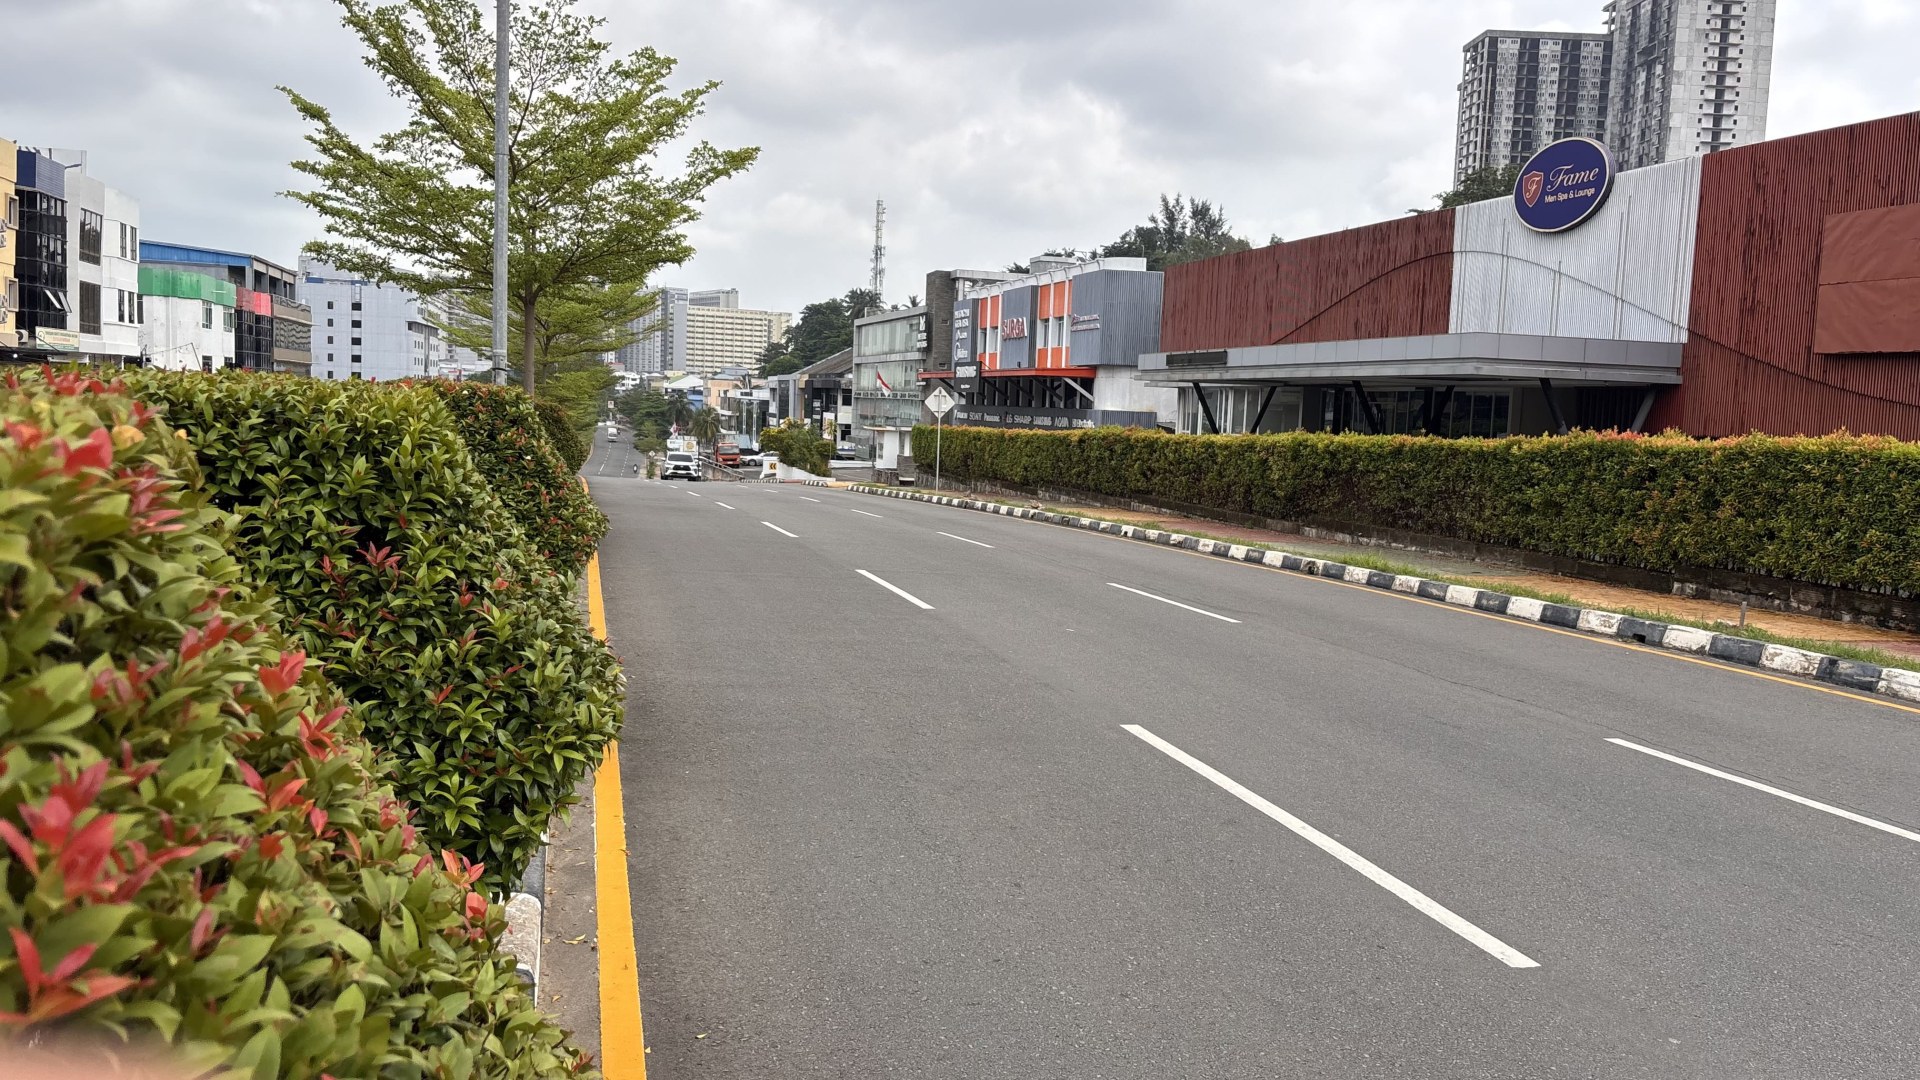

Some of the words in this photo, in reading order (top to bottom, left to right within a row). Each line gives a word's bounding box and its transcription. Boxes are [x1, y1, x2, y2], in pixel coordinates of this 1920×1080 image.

[1546, 164, 1599, 192] Fame
[1545, 195, 1557, 203] Men
[1557, 192, 1568, 202] Spa
[1569, 190, 1574, 199] &
[1575, 187, 1595, 198] Lounge
[1002, 317, 1027, 339] SURGA
[969, 411, 982, 421] SONY
[1006, 414, 1013, 423] LG
[1014, 415, 1032, 424] SHARP
